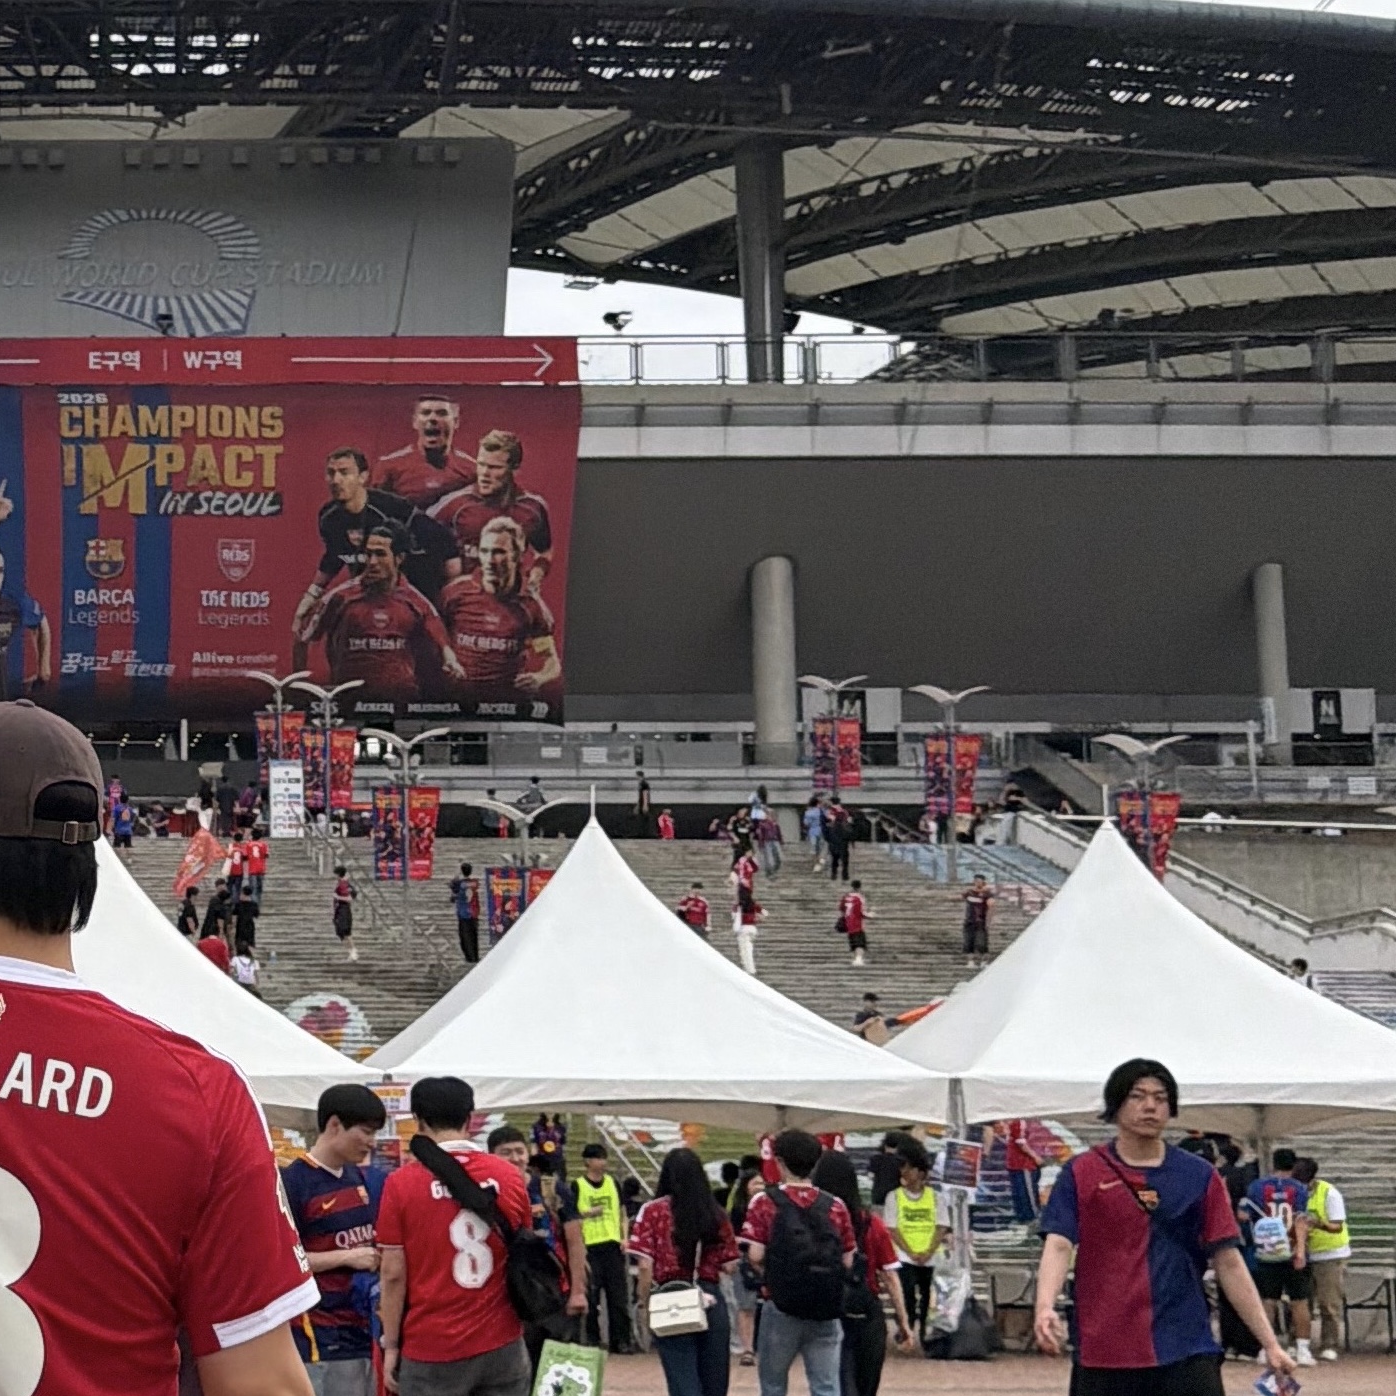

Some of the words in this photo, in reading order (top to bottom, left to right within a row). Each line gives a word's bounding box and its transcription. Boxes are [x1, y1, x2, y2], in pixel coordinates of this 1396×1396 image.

[52, 260, 159, 290] WORLD
[170, 260, 235, 290] CUP
[247, 258, 385, 290] STADIUM
[88, 351, 141, 372] E구역
[183, 350, 243, 371] W구역
[59, 403, 285, 439] CHAMPIONS
[62, 443, 284, 515] IMPACT
[194, 491, 282, 516] SEOUL
[74, 588, 135, 608] BARÇA
[68, 608, 140, 628] Legends
[198, 610, 270, 629] Legends
[450, 1208, 493, 1289] 8
